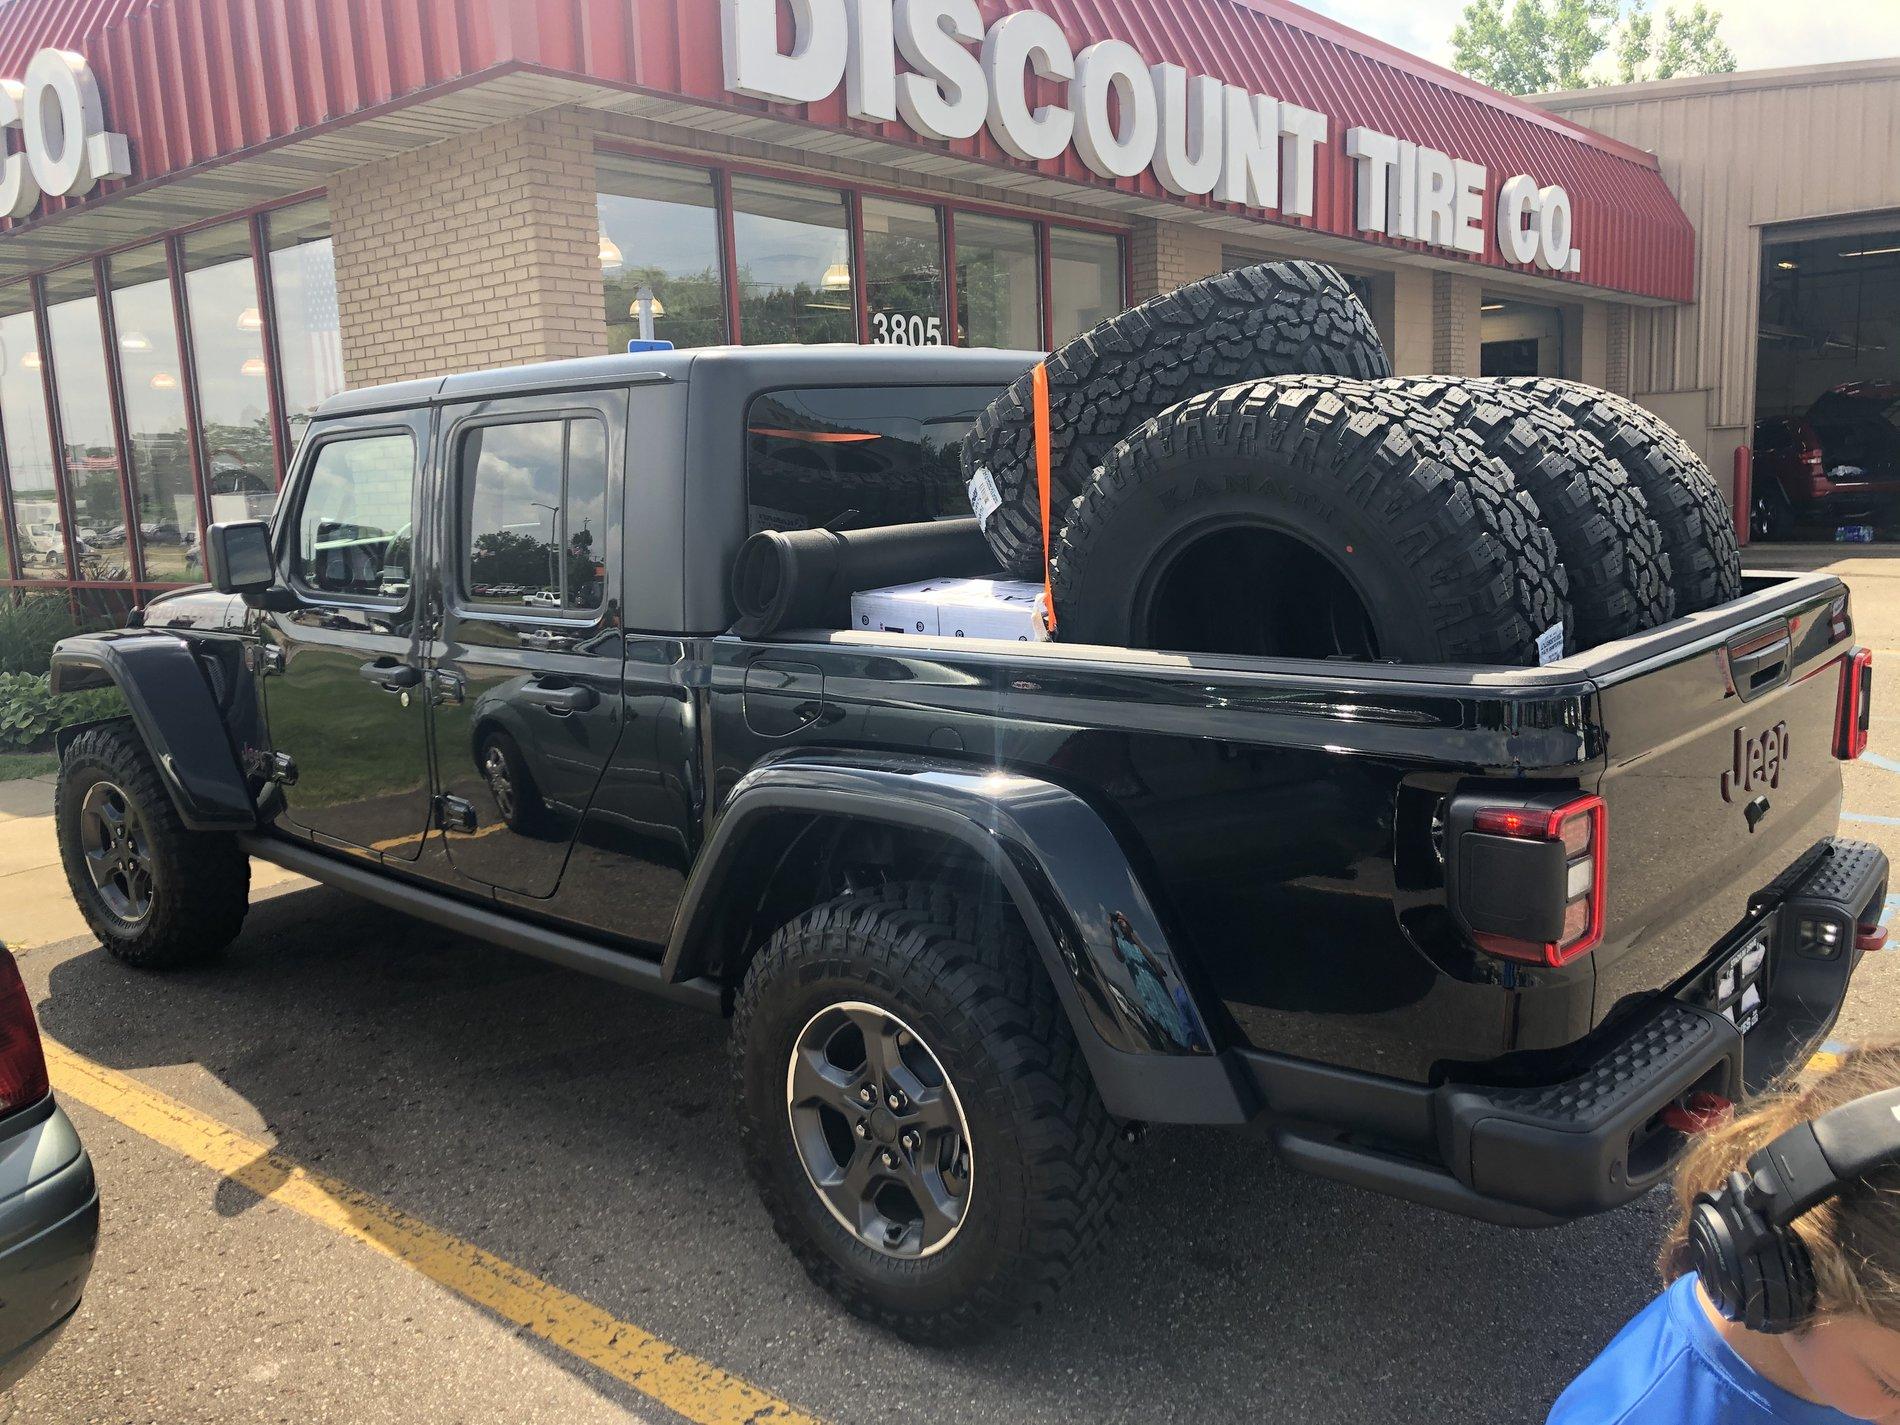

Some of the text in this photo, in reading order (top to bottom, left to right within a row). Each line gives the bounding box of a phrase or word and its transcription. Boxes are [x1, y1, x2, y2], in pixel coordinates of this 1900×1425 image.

[723, 0, 1581, 273] DISCOUNT TIRE CO.
[873, 312, 942, 346] 3805
[1720, 720, 1789, 805] Jeep
